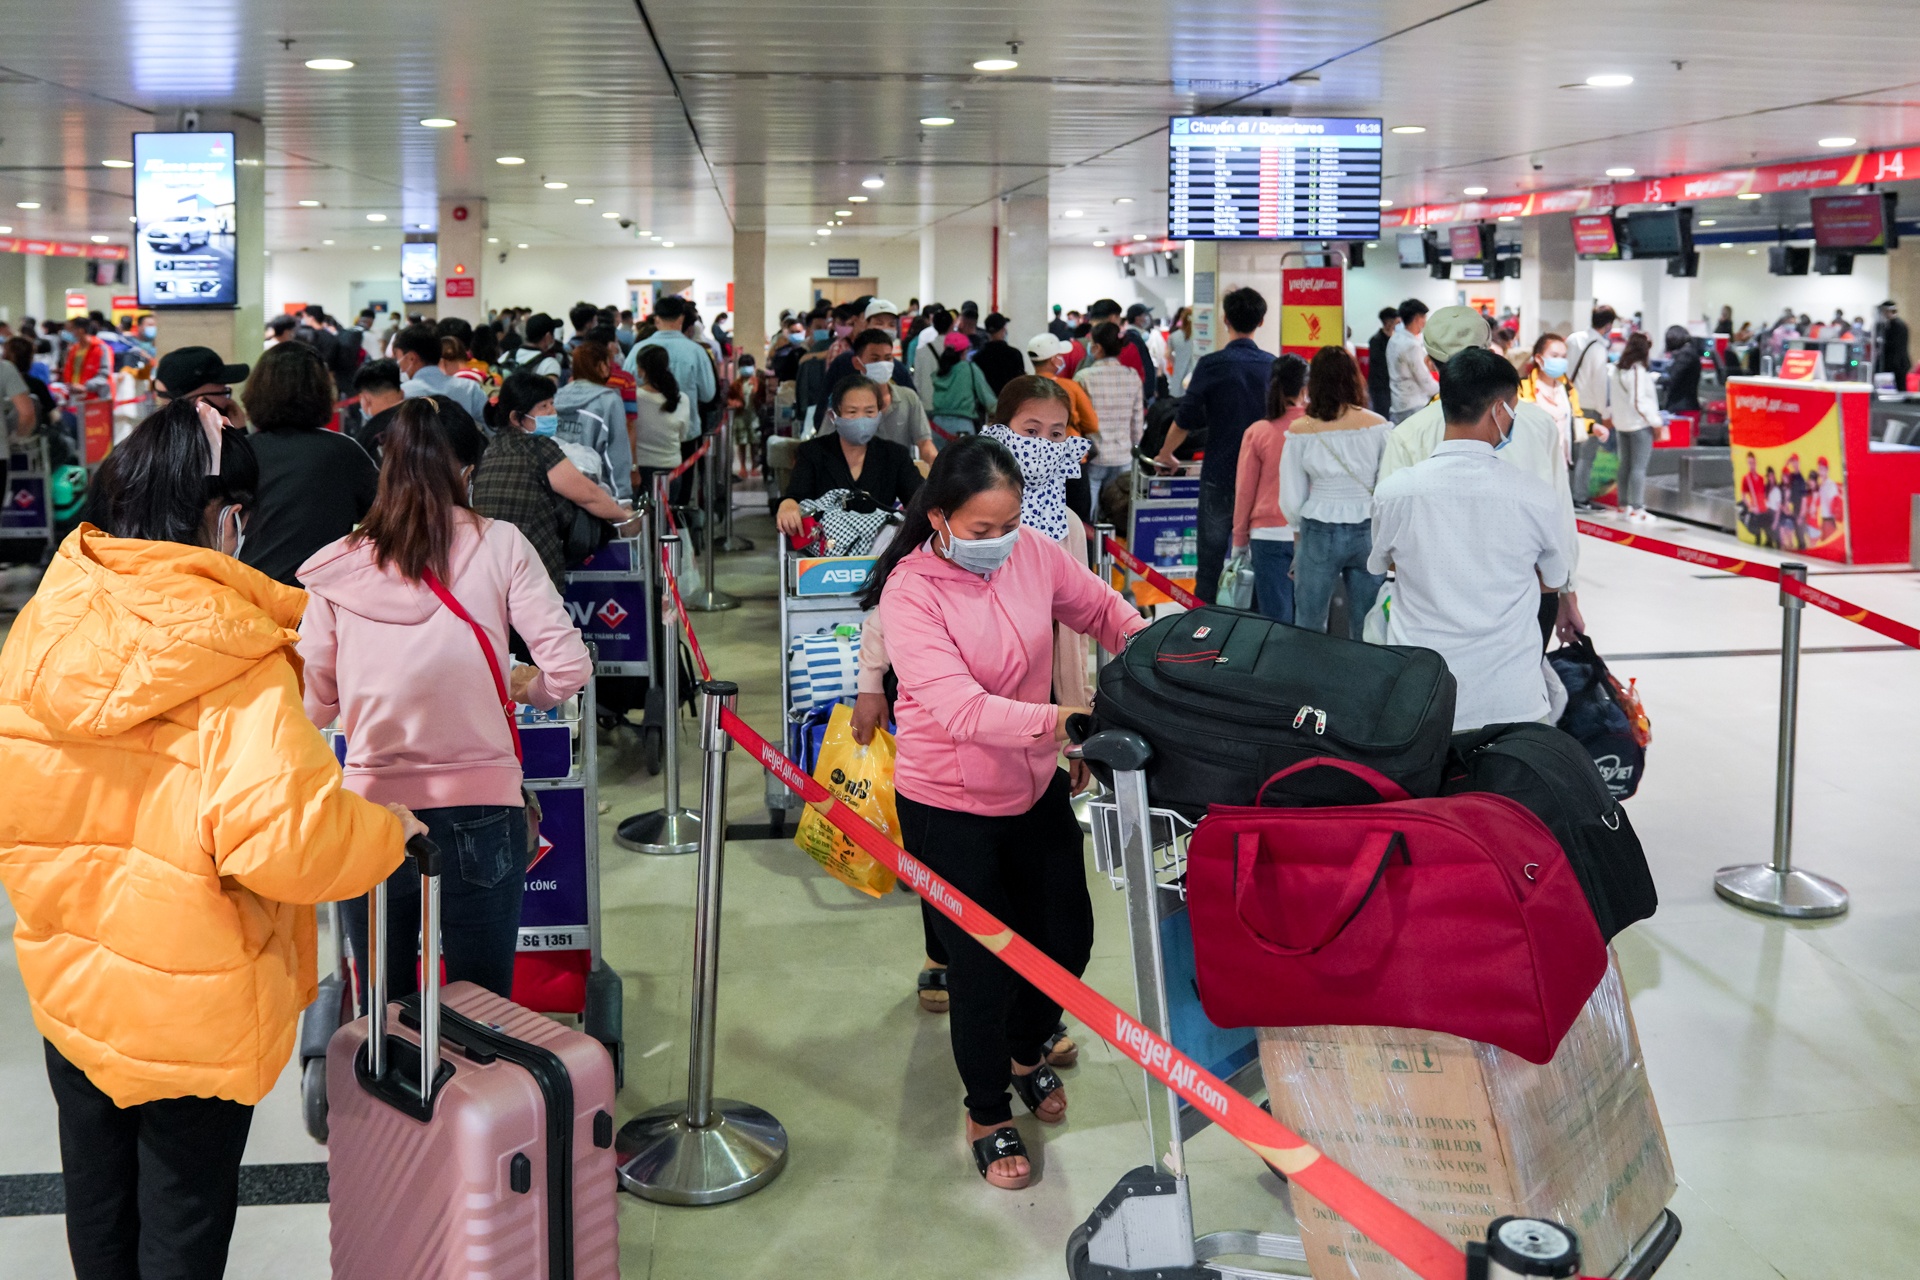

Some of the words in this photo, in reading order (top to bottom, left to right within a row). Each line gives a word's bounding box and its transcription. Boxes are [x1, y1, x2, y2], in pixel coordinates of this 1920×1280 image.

[1190, 120, 1235, 134] Chuyến
[1237, 122, 1249, 134] đi
[1260, 122, 1324, 135] Departures
[1874, 152, 1904, 180] J-4
[1643, 180, 1662, 202] J-5
[615, 632, 631, 640] CÔNG
[530, 879, 557, 891] CÔNG
[523, 934, 540, 946] SG
[544, 934, 572, 946] 1351
[1424, 1117, 1454, 1132] XUẤT
[1455, 1118, 1476, 1135] SẢN
[1454, 1139, 1482, 1156] KÍCH
[1458, 1160, 1487, 1178] NGÀY
[1452, 1178, 1492, 1196] TRỌNG
